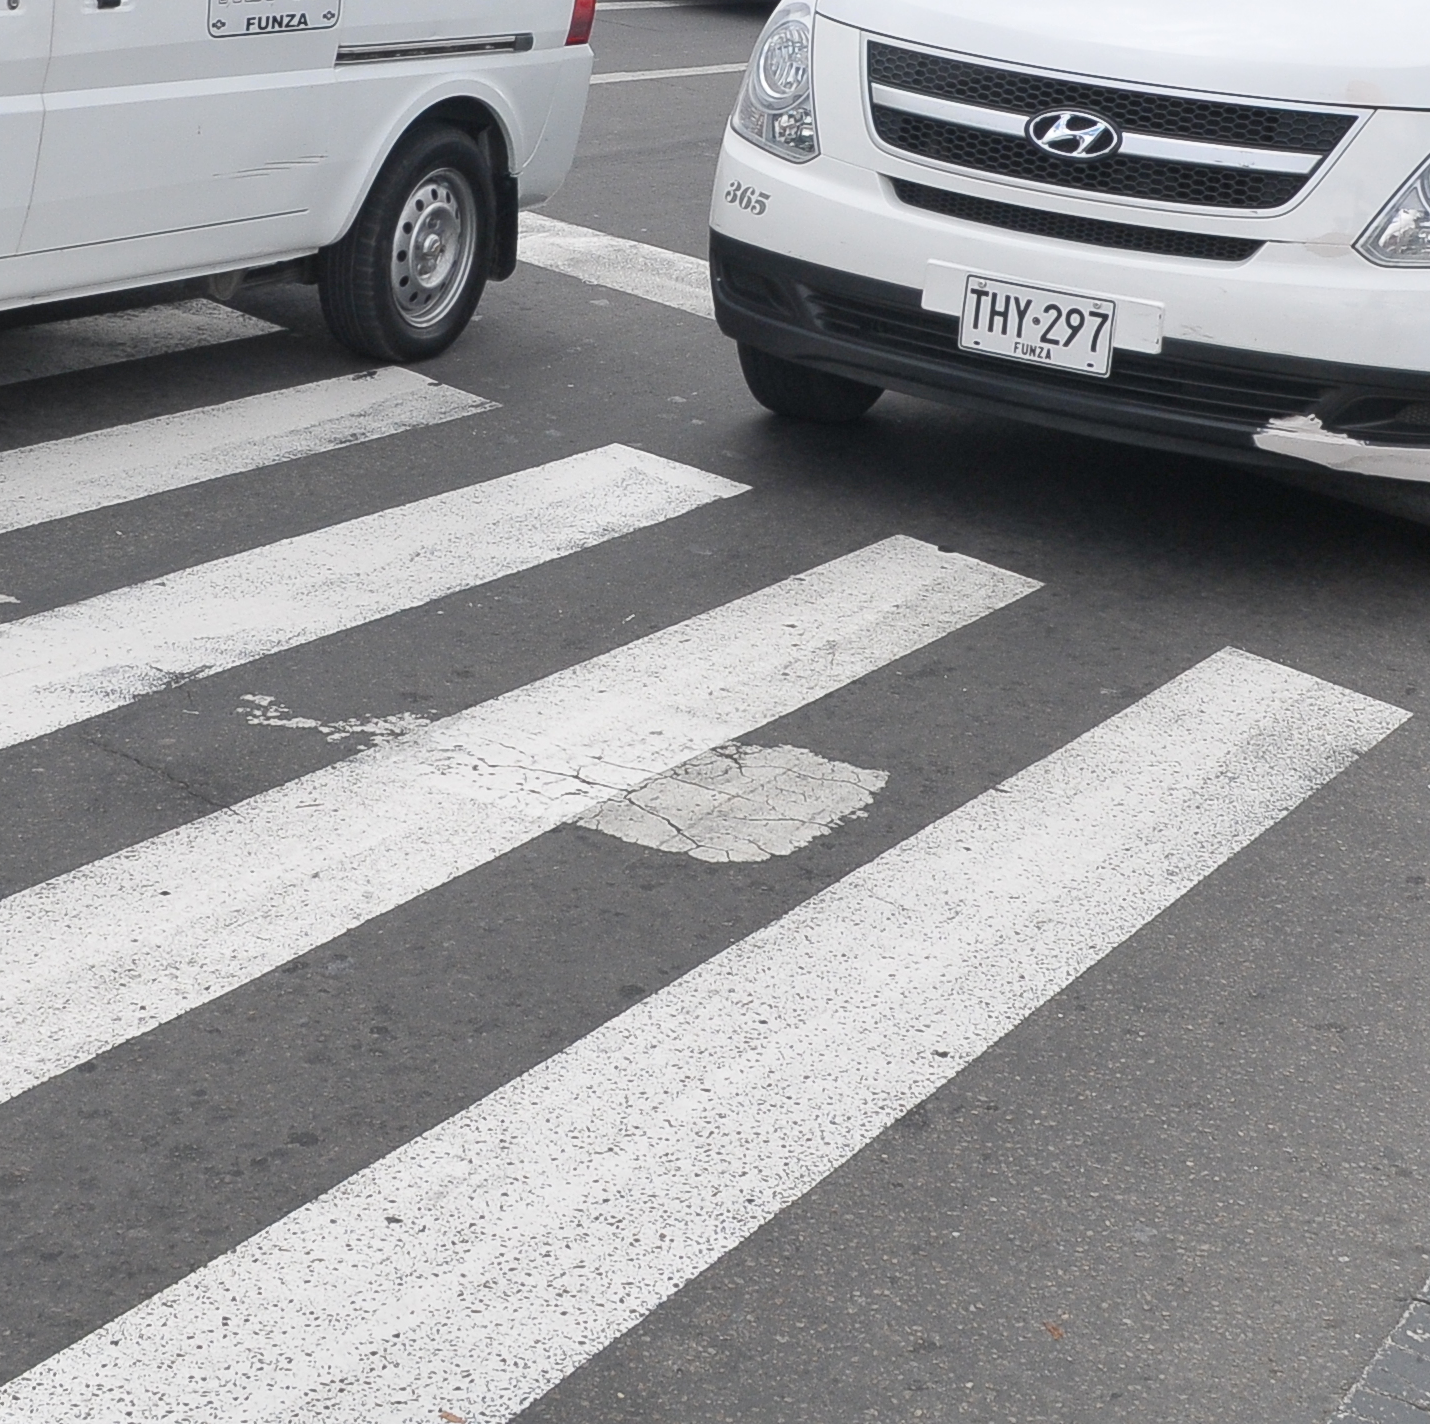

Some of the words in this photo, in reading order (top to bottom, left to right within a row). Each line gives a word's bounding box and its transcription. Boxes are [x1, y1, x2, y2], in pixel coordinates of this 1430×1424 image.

[246, 12, 309, 31] FUNZA
[724, 179, 771, 216] 365
[1013, 331, 1052, 361] FUNZA
